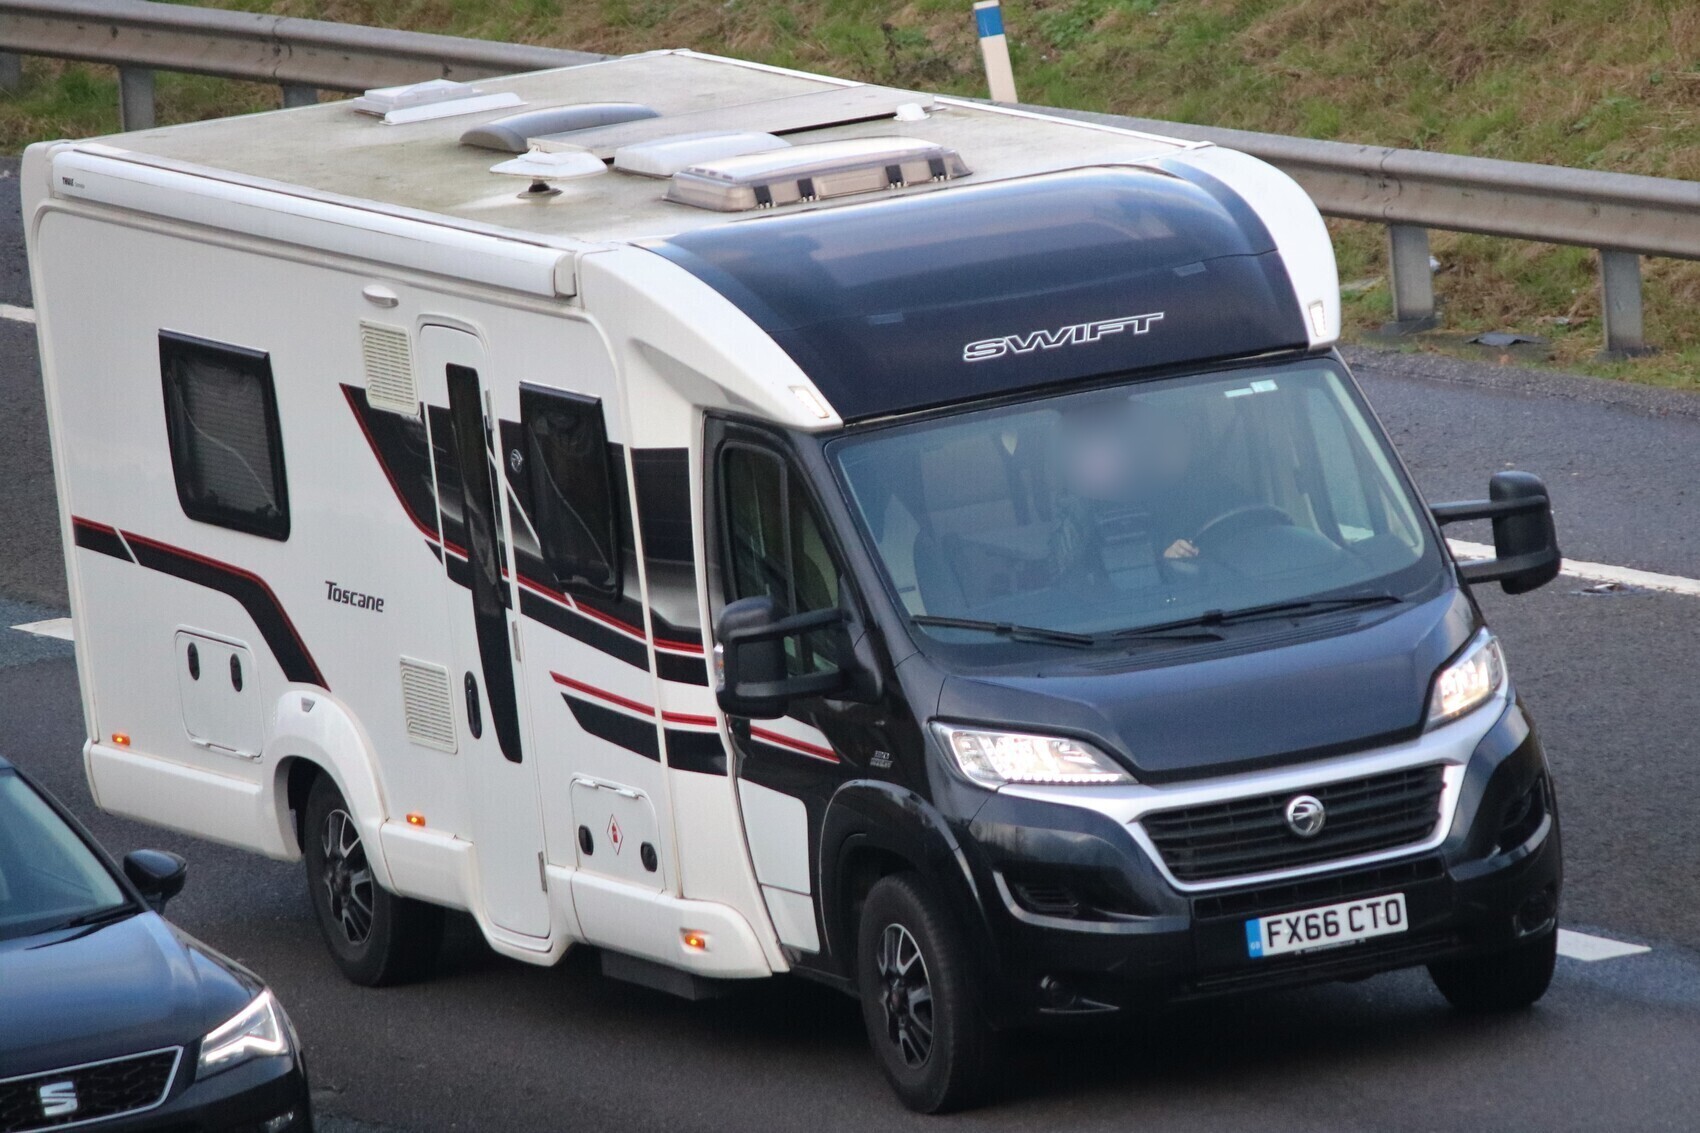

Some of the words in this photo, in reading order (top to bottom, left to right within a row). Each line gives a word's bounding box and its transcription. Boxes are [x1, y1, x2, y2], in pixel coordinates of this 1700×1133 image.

[963, 311, 1165, 362] SWIFT
[325, 580, 385, 613] Toscane
[1266, 910, 1340, 948] FX66
[1348, 898, 1402, 933] CTO
